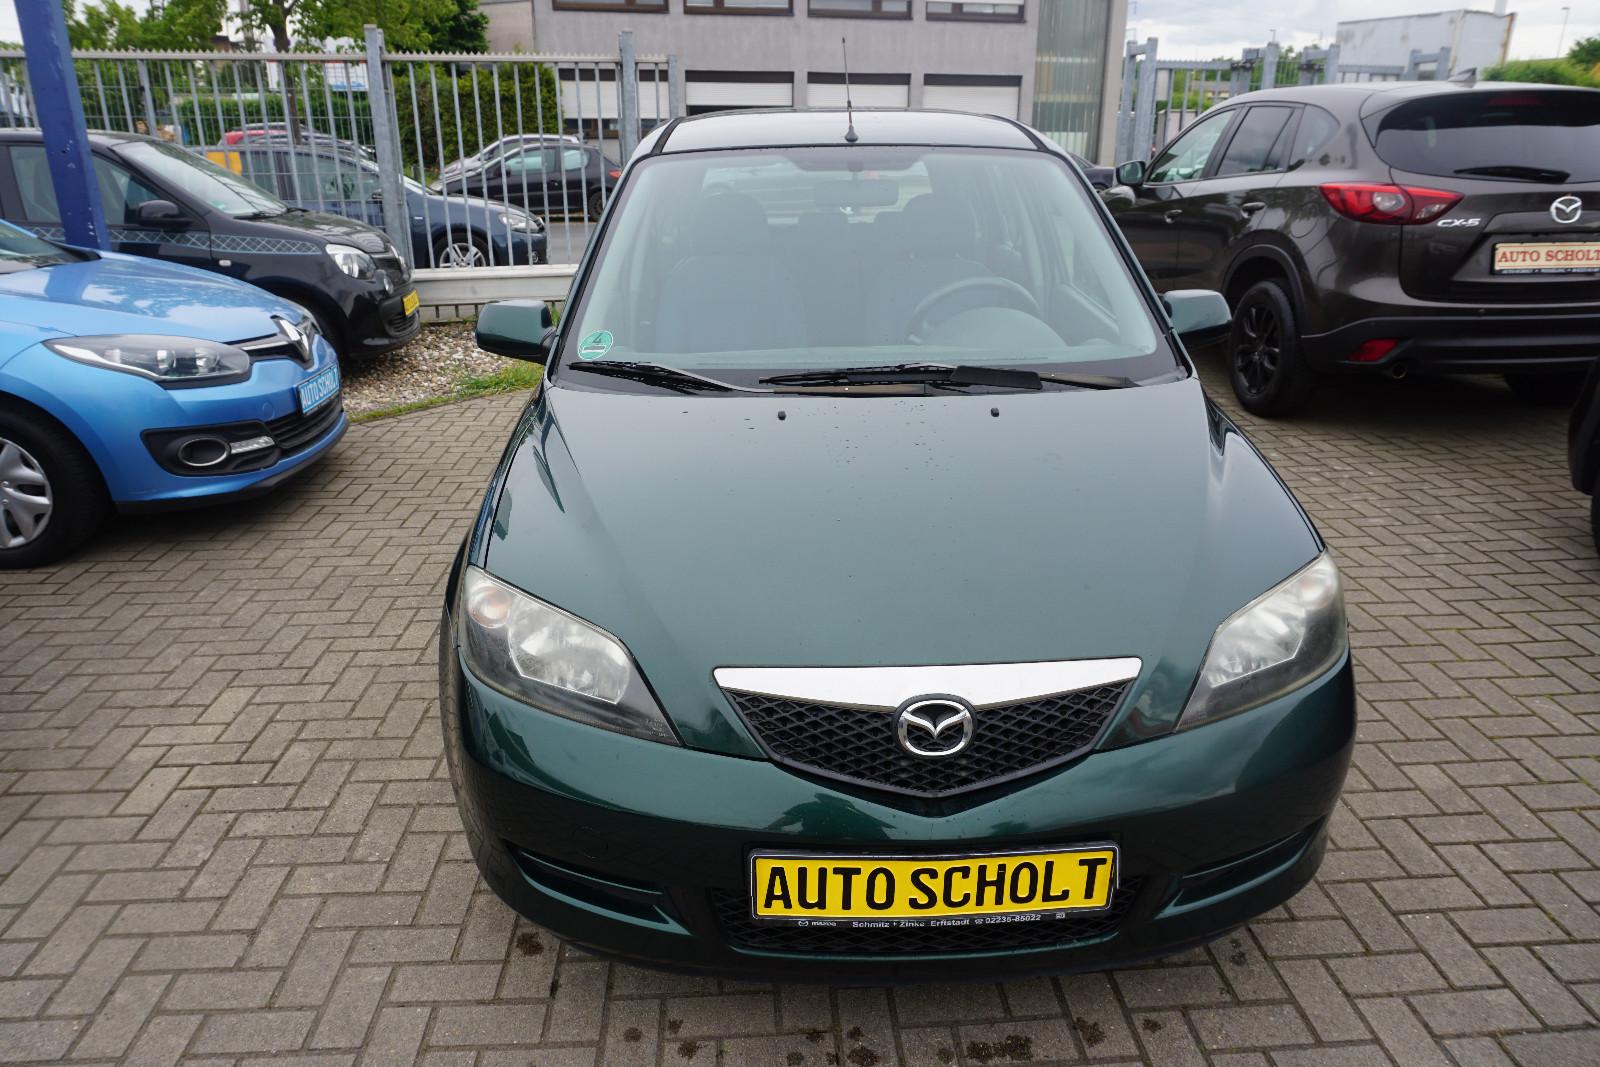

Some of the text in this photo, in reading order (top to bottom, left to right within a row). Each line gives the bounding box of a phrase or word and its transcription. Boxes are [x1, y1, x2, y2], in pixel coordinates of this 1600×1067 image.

[1437, 218, 1481, 227] CX-5
[1498, 250, 1541, 263] AUTO
[592, 333, 603, 344] 4
[300, 382, 319, 408] AUTO
[763, 866, 896, 910] AUTO
[900, 920, 925, 928] Zinke
